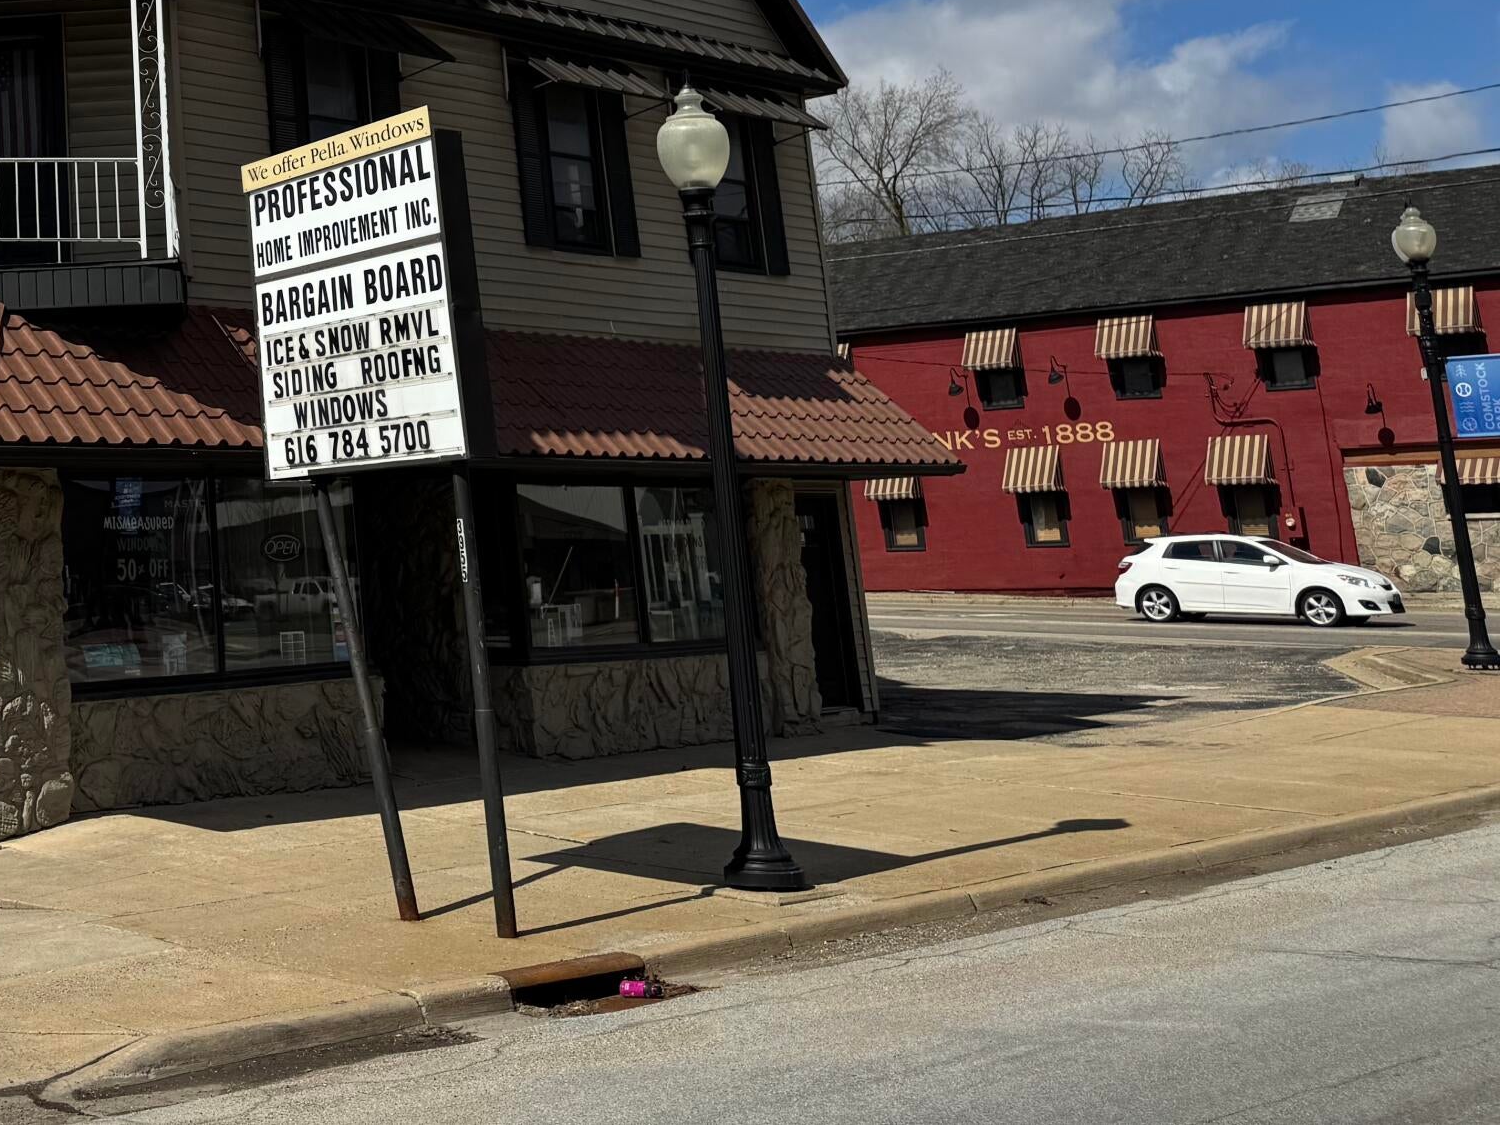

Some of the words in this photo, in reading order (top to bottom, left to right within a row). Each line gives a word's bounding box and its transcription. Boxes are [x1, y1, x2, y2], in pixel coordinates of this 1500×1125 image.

[247, 164, 268, 183] We
[272, 154, 306, 176] offer
[310, 141, 347, 164] Pella
[349, 117, 424, 152] Windows
[253, 144, 431, 226] PROFESSIONAL
[256, 235, 293, 268] HOME
[297, 205, 399, 258] IMPROVEMENT
[404, 197, 437, 230] INC.
[261, 273, 354, 326] BARGAIN
[363, 254, 443, 305] BOARD
[266, 336, 295, 367] ICE
[299, 333, 310, 360] &
[314, 321, 370, 357] SNOW
[379, 308, 439, 346] RMVL
[273, 361, 338, 399] SIDING
[360, 344, 442, 385] ROOFNG
[1474, 361, 1495, 430] COMSTOCK
[293, 389, 388, 429] WINDOWS
[1008, 428, 1037, 441] EST.
[1042, 421, 1115, 446] 1888
[284, 434, 318, 466] 616
[328, 428, 370, 460] 784
[379, 420, 431, 454] 5700
[116, 536, 167, 553] WINDO
[148, 557, 169, 579] OFF
[264, 539, 301, 555] OPEN
